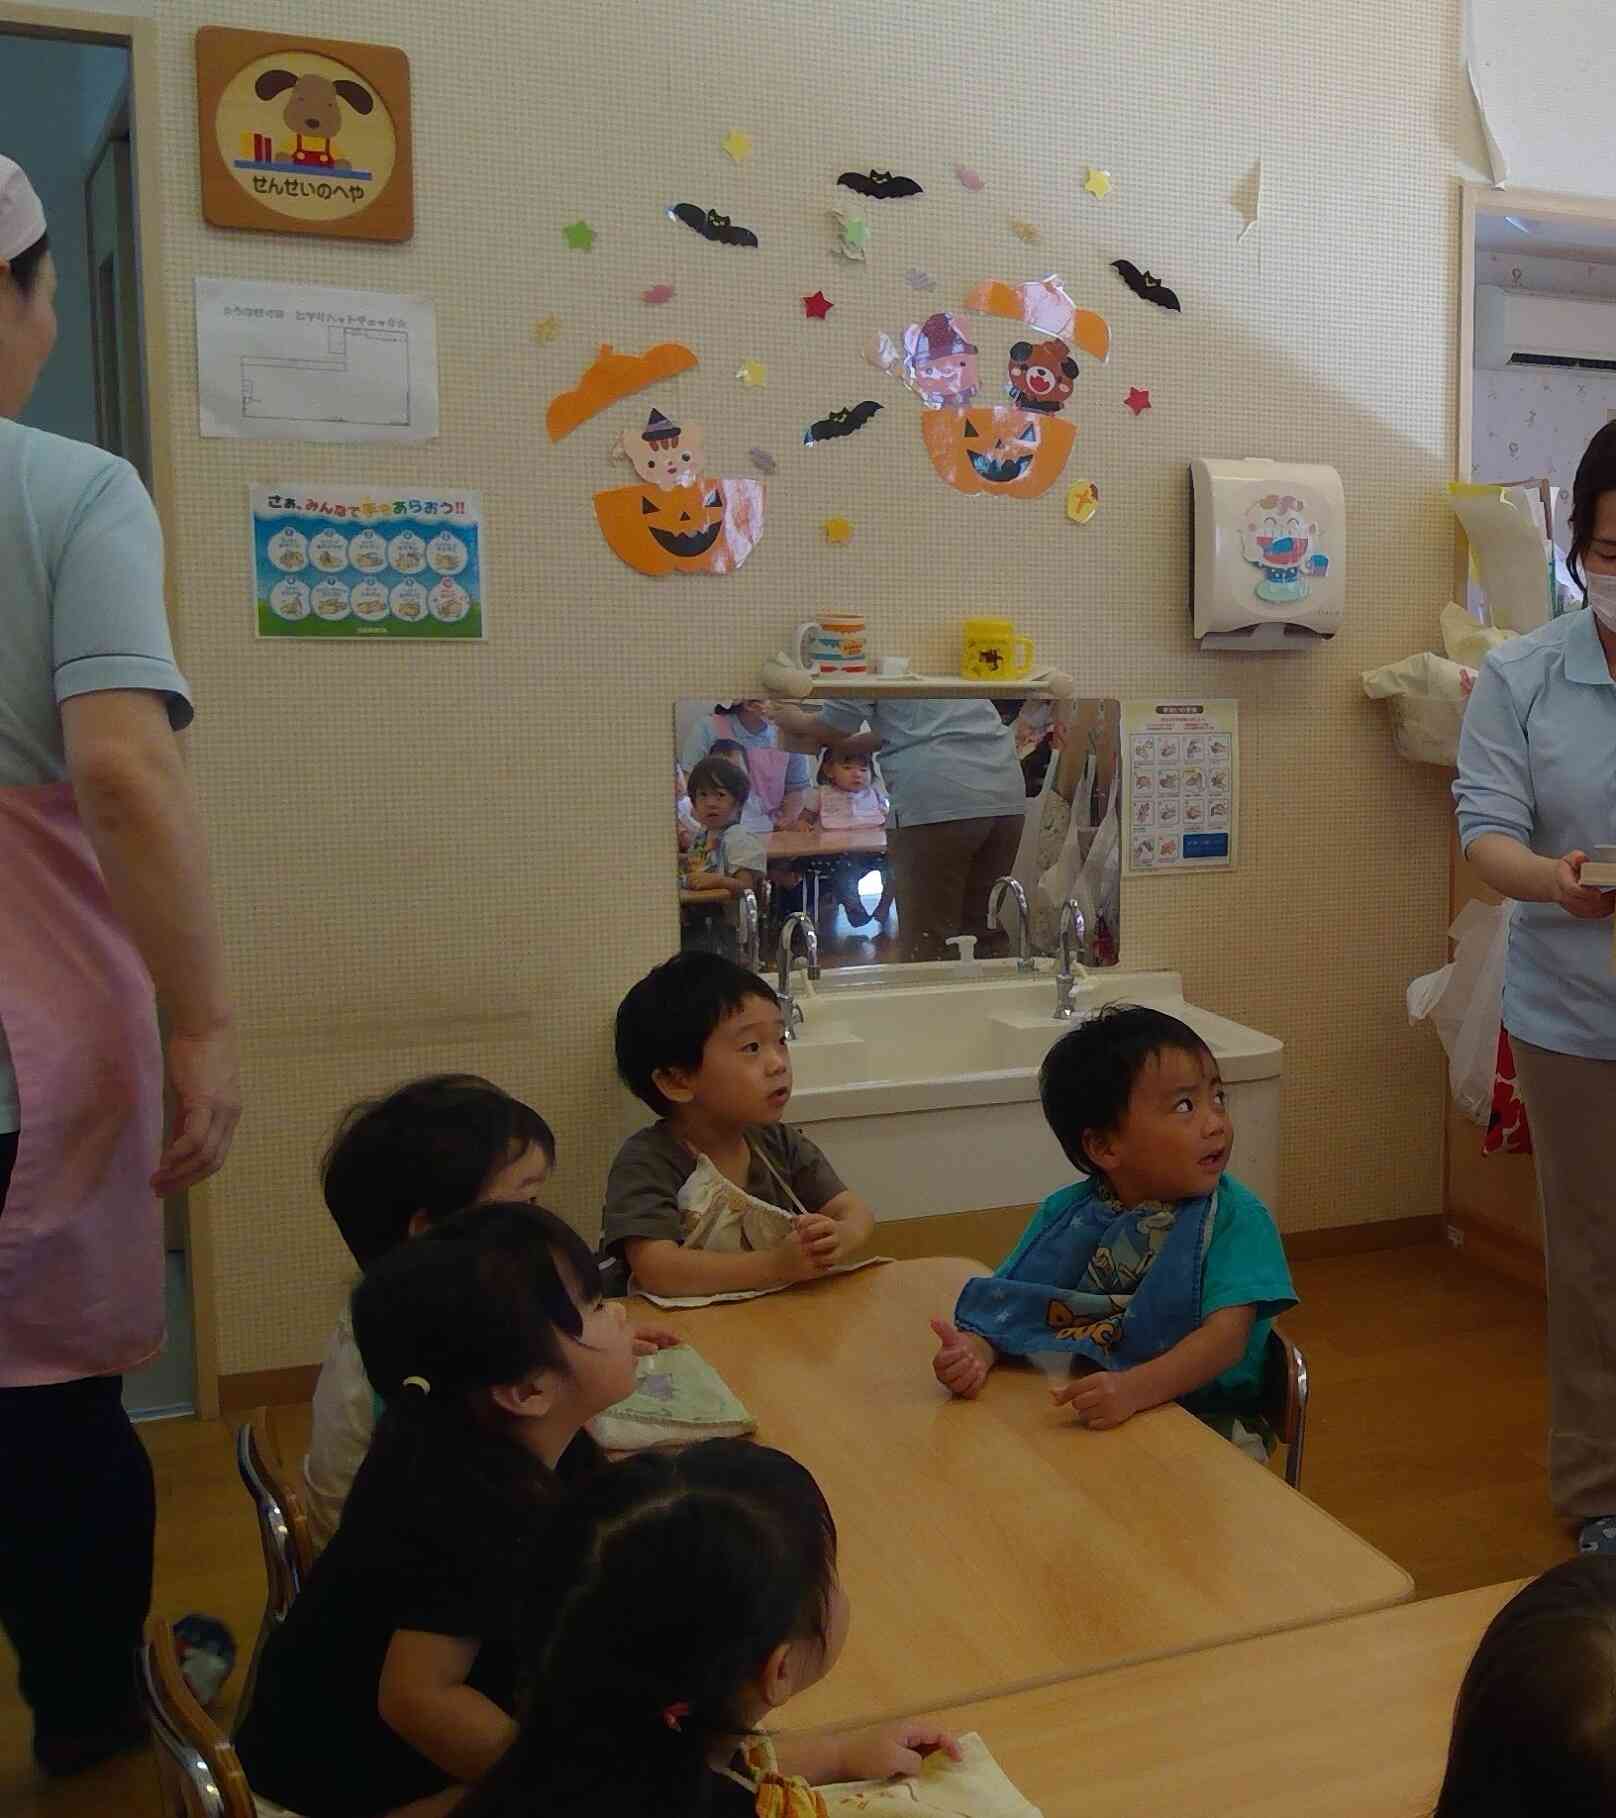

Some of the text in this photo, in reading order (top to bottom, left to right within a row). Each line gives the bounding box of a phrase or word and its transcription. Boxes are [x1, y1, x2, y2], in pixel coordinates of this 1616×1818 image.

[252, 175, 366, 203] せんせいのへや
